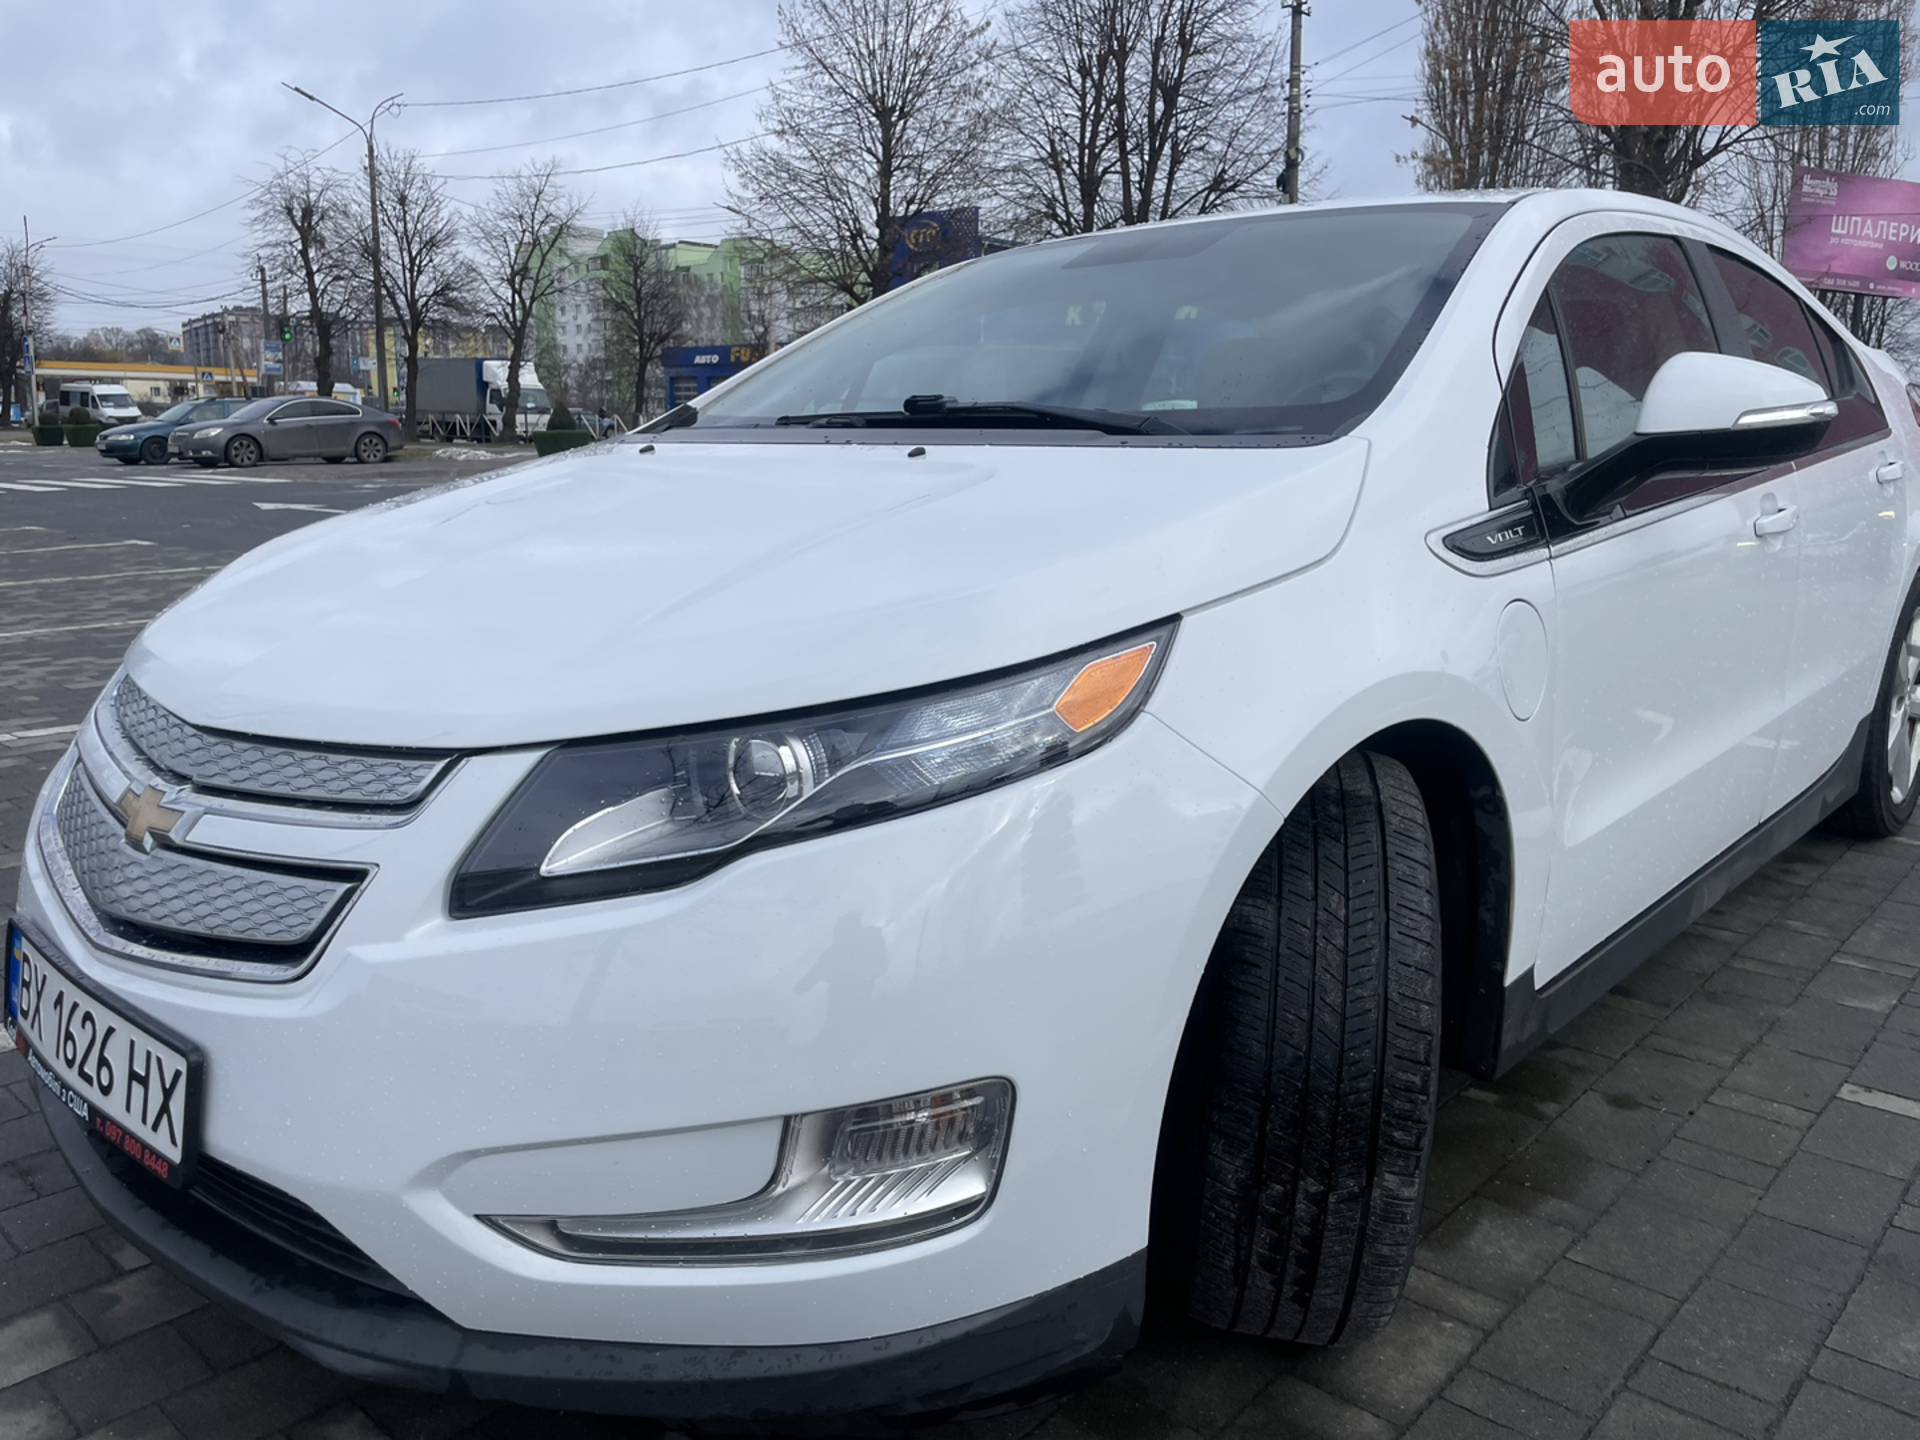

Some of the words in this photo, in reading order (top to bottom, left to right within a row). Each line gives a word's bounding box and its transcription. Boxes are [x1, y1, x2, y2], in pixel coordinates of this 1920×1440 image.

[1830, 213, 1920, 245] ШПАЛЕРИ
[1486, 525, 1525, 545] VOLT
[53, 990, 116, 1097] 1626
[67, 1091, 89, 1121] США
[105, 1120, 123, 1144] 097
[124, 1134, 142, 1159] 800
[143, 1148, 169, 1179] 8448
